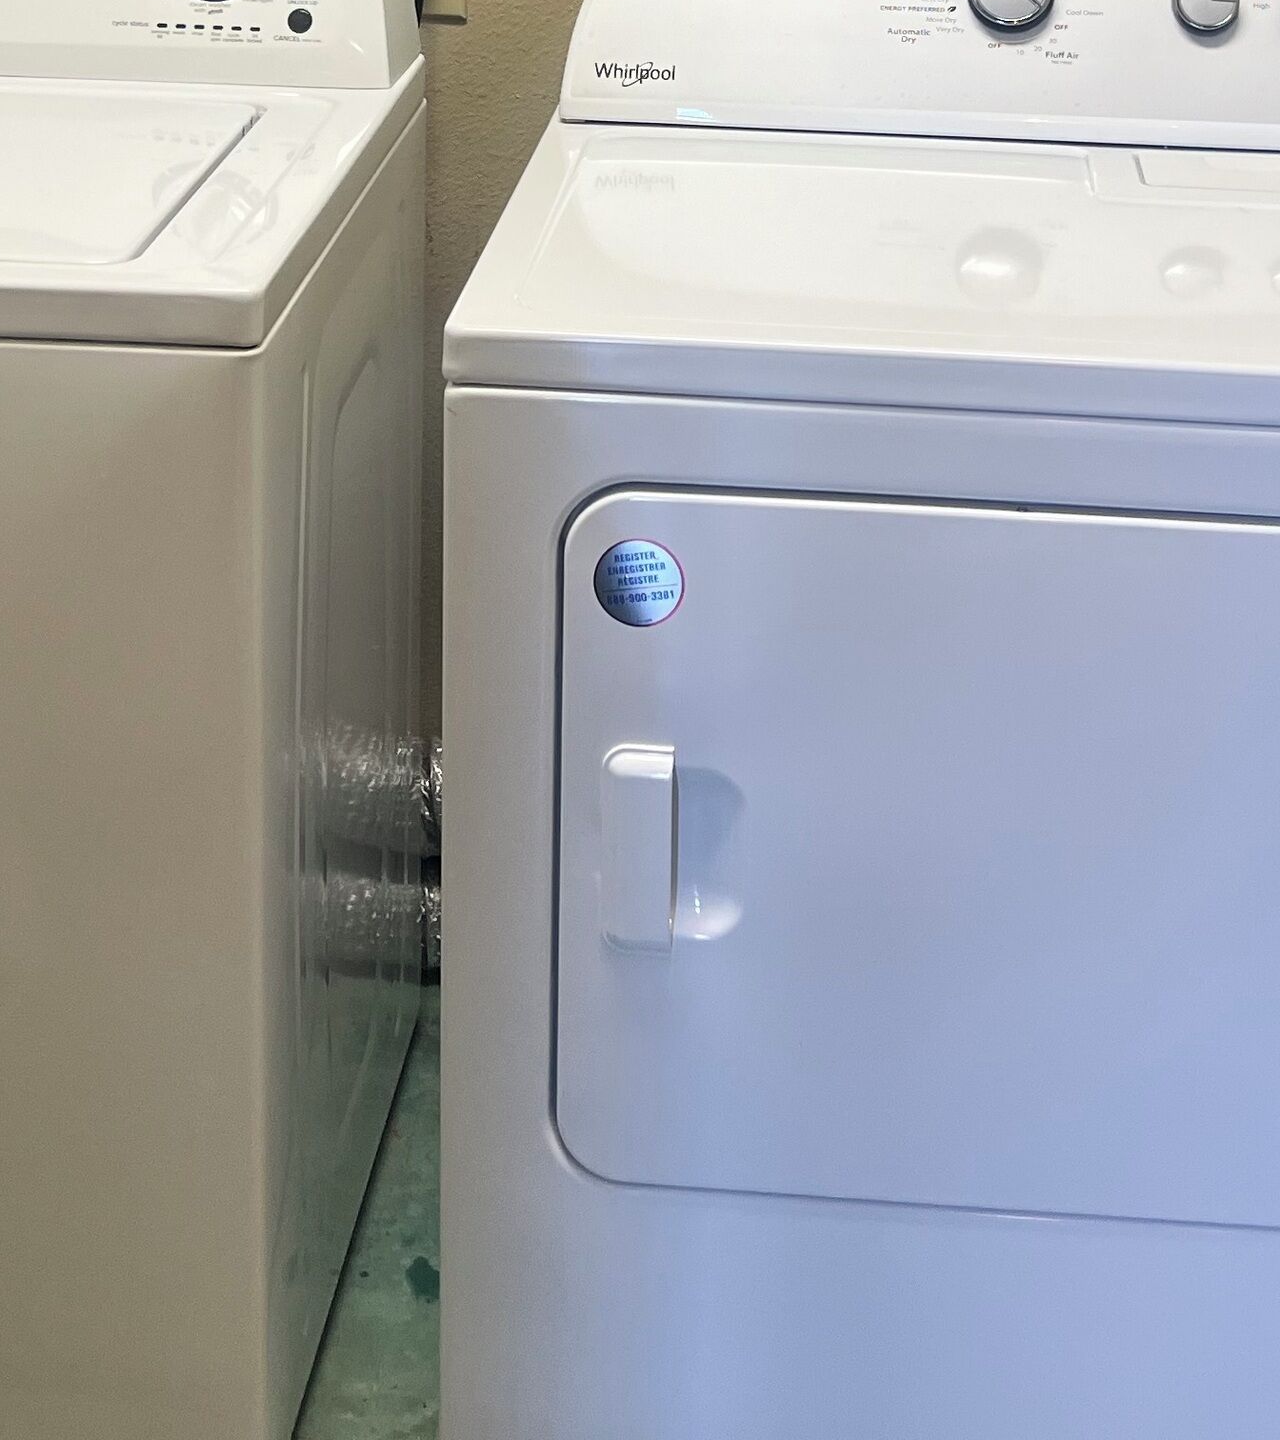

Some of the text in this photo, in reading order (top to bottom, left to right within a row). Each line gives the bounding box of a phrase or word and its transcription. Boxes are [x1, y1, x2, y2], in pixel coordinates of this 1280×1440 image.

[888, 28, 931, 36] Automatic
[901, 36, 916, 45] Dry
[1045, 51, 1080, 59] Fluff Air
[594, 61, 676, 87] Whirlpool
[614, 551, 656, 563] REGISTER
